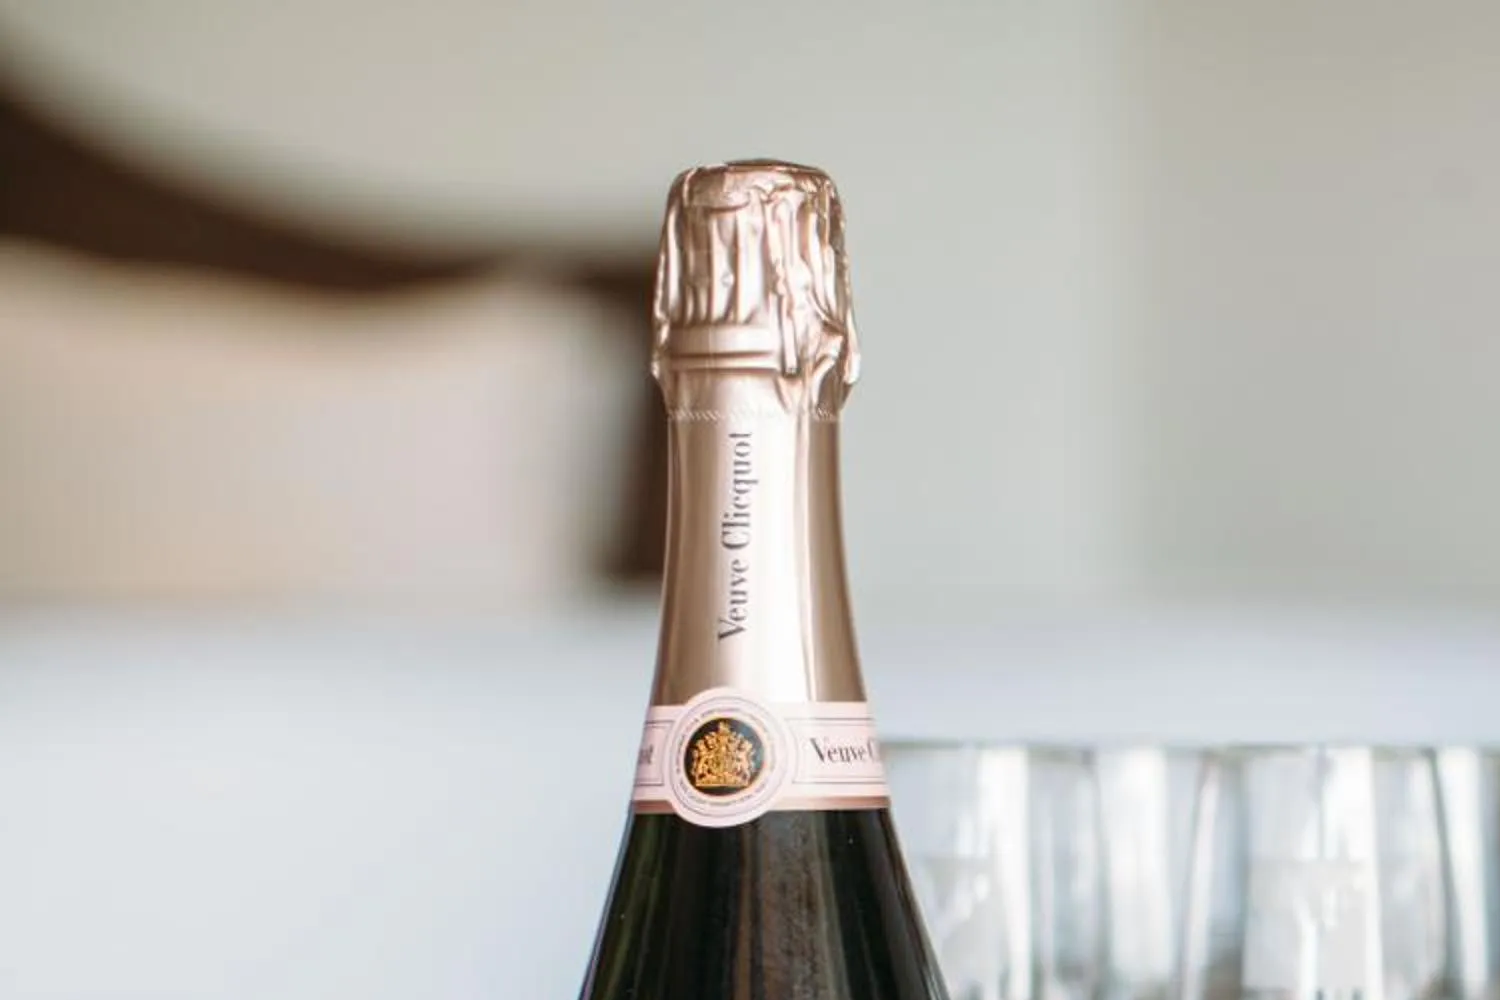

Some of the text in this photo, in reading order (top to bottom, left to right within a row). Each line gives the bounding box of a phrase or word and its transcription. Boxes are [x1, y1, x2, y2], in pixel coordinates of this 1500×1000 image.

[718, 432, 760, 643] Veuve Clicquot
[809, 737, 868, 764] Veuve
